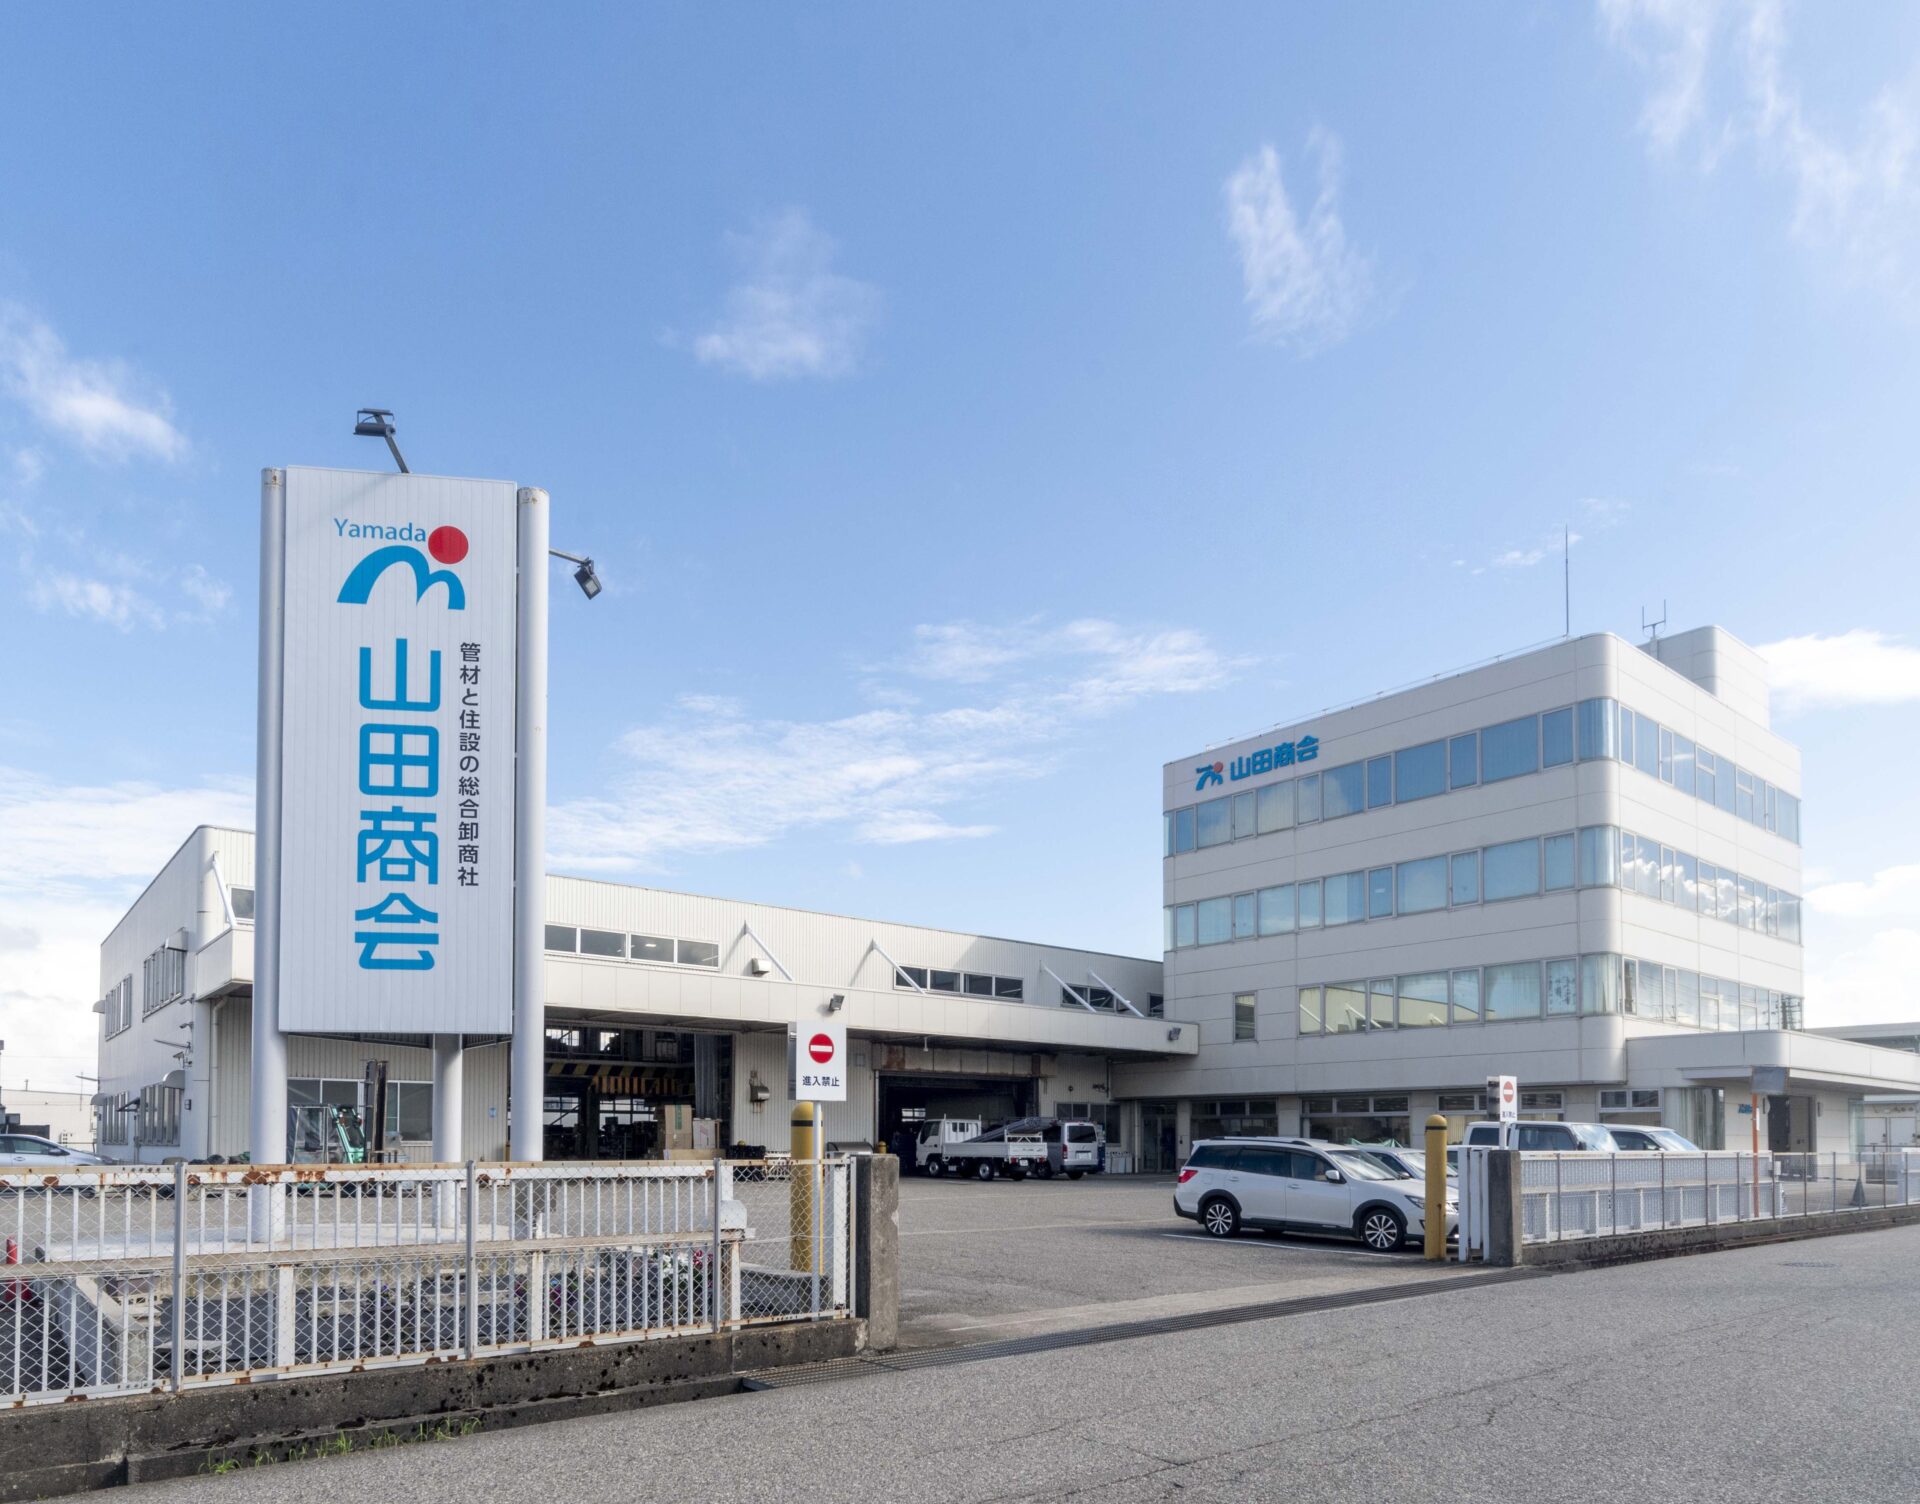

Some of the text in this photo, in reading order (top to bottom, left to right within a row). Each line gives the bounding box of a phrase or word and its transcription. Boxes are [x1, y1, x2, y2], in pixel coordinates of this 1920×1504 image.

[333, 518, 426, 542] Yamada
[458, 642, 481, 887] 管材と住設の総合卸商社
[1230, 735, 1319, 781] 山田商会
[355, 638, 441, 970] 山田商会
[802, 1076, 840, 1087] 進入禁止
